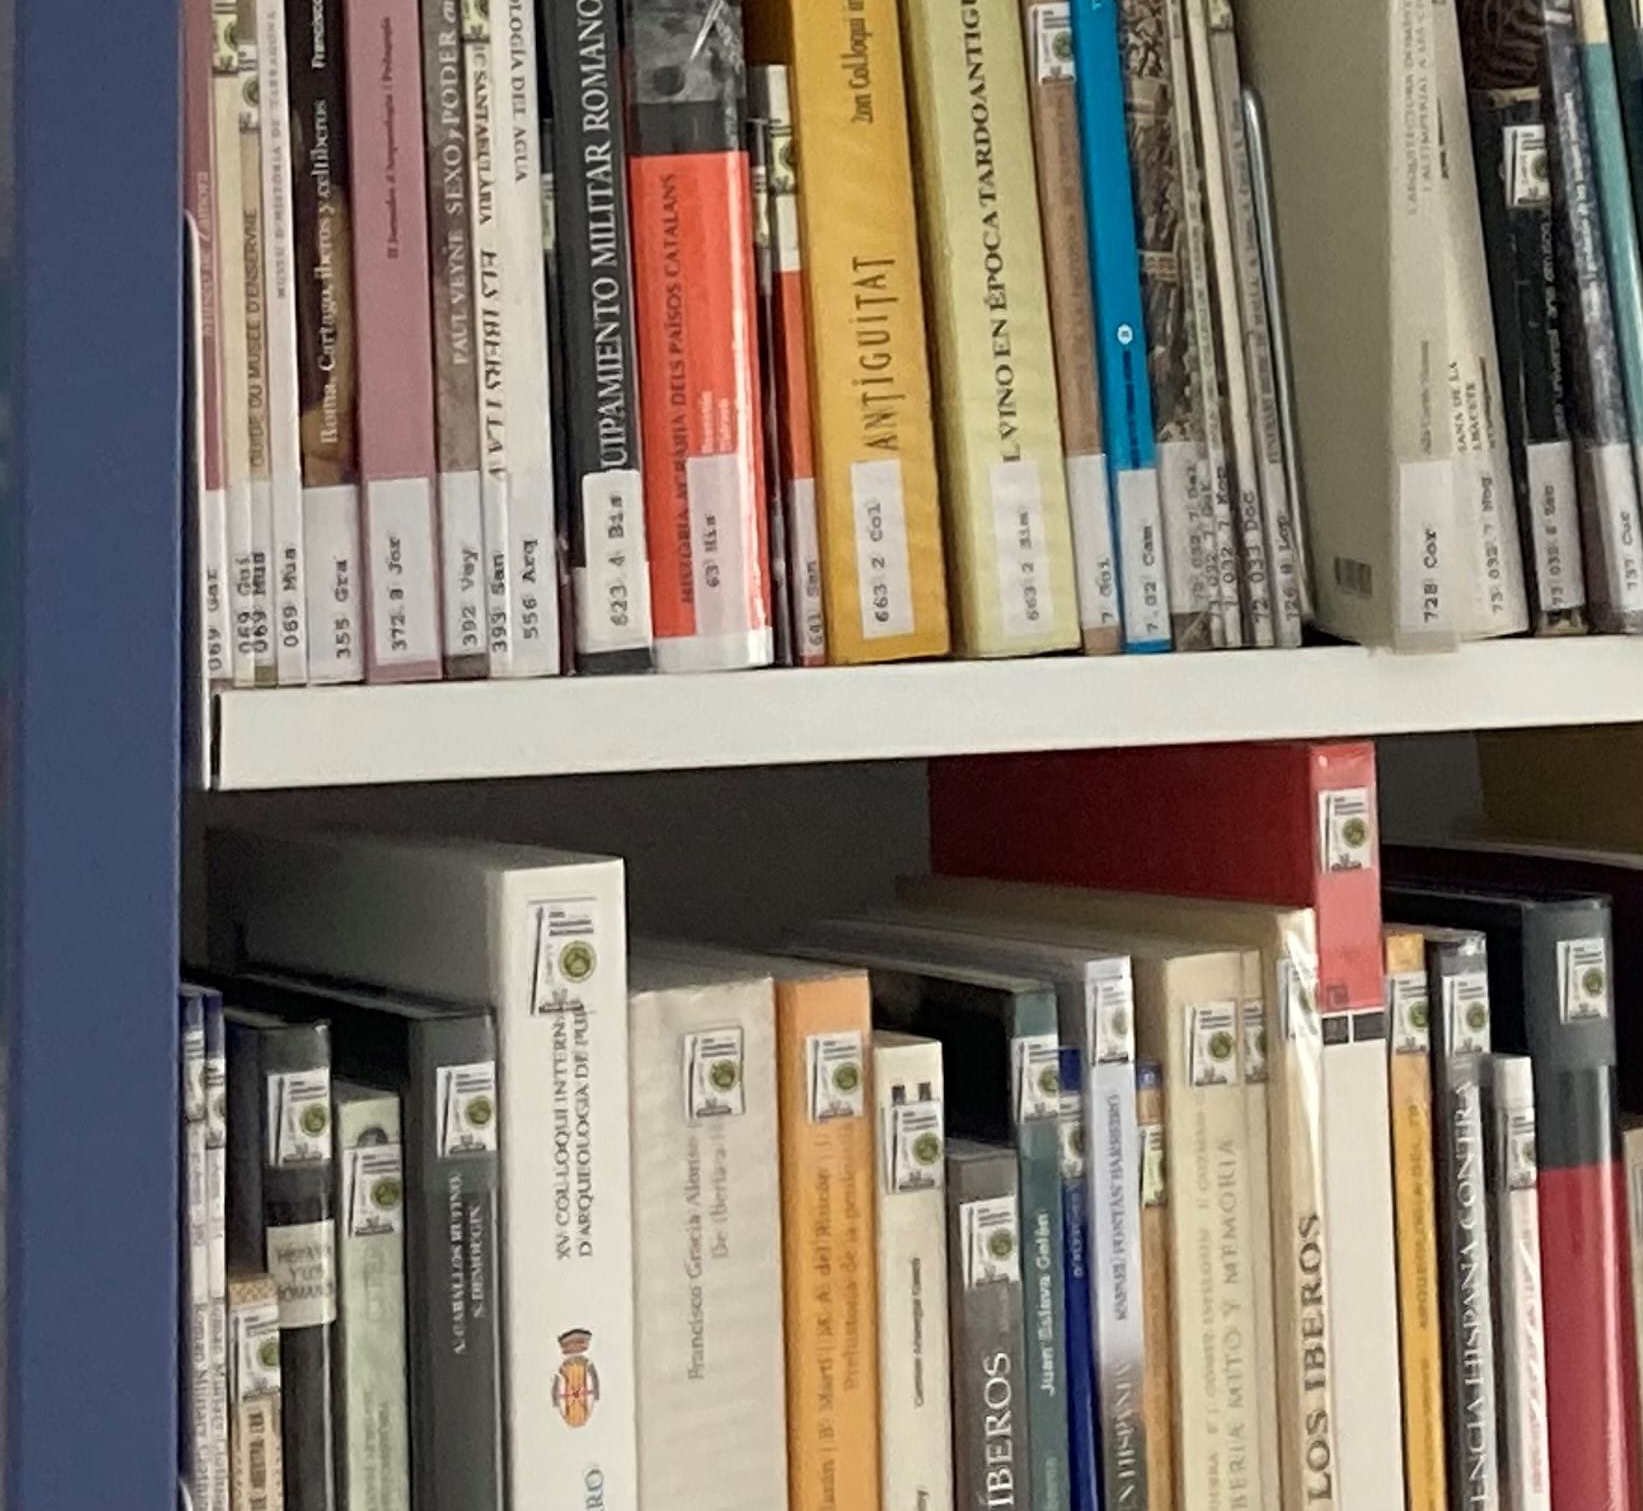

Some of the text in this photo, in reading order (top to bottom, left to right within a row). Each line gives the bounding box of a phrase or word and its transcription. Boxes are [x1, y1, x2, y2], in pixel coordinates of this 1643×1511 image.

[439, 30, 461, 124] PODER
[510, 75, 526, 121] DEL
[443, 144, 463, 216] SEXO
[513, 124, 529, 182] AGUA
[317, 205, 333, 214] y
[583, 140, 618, 267] MILITAR
[312, 217, 331, 281] iberos
[446, 229, 467, 304] VEYNE
[982, 210, 1007, 312] ÉPOCA
[659, 173, 688, 407] DELS PAÏSOS CATALANS
[451, 311, 469, 365] PAUL
[480, 248, 507, 455] ELS IBERS I LA
[591, 278, 629, 468] UIPAMIENTO
[989, 318, 1012, 358] EN
[318, 375, 340, 445] Roma,
[993, 364, 1018, 439] VINO
[387, 536, 403, 575] Jor
[703, 513, 719, 588] 63 His
[864, 501, 884, 543] Col
[282, 545, 299, 649] 069 Mus
[333, 555, 352, 660] 355 Gra
[488, 552, 506, 596] San
[521, 538, 539, 640] 556 Arq
[1421, 579, 1439, 624] 728
[460, 604, 478, 647] 392
[573, 1055, 594, 1258] D'ARQUEOLOGIA DE
[555, 1232, 572, 1261] XV
[682, 1135, 705, 1380] Francisco Gracia Alonso
[711, 1231, 729, 1259] De
[840, 1280, 860, 1391] Prehistoria
[1036, 1275, 1054, 1342] Eslava
[1217, 1137, 1248, 1509] BERIA MITO Y MEMORIA
[1458, 1238, 1485, 1387] HISPANA
[1039, 1346, 1057, 1398] Juan
[1297, 1211, 1334, 1505] LOS IBEROS
[1465, 1396, 1490, 1502] ENCIA
